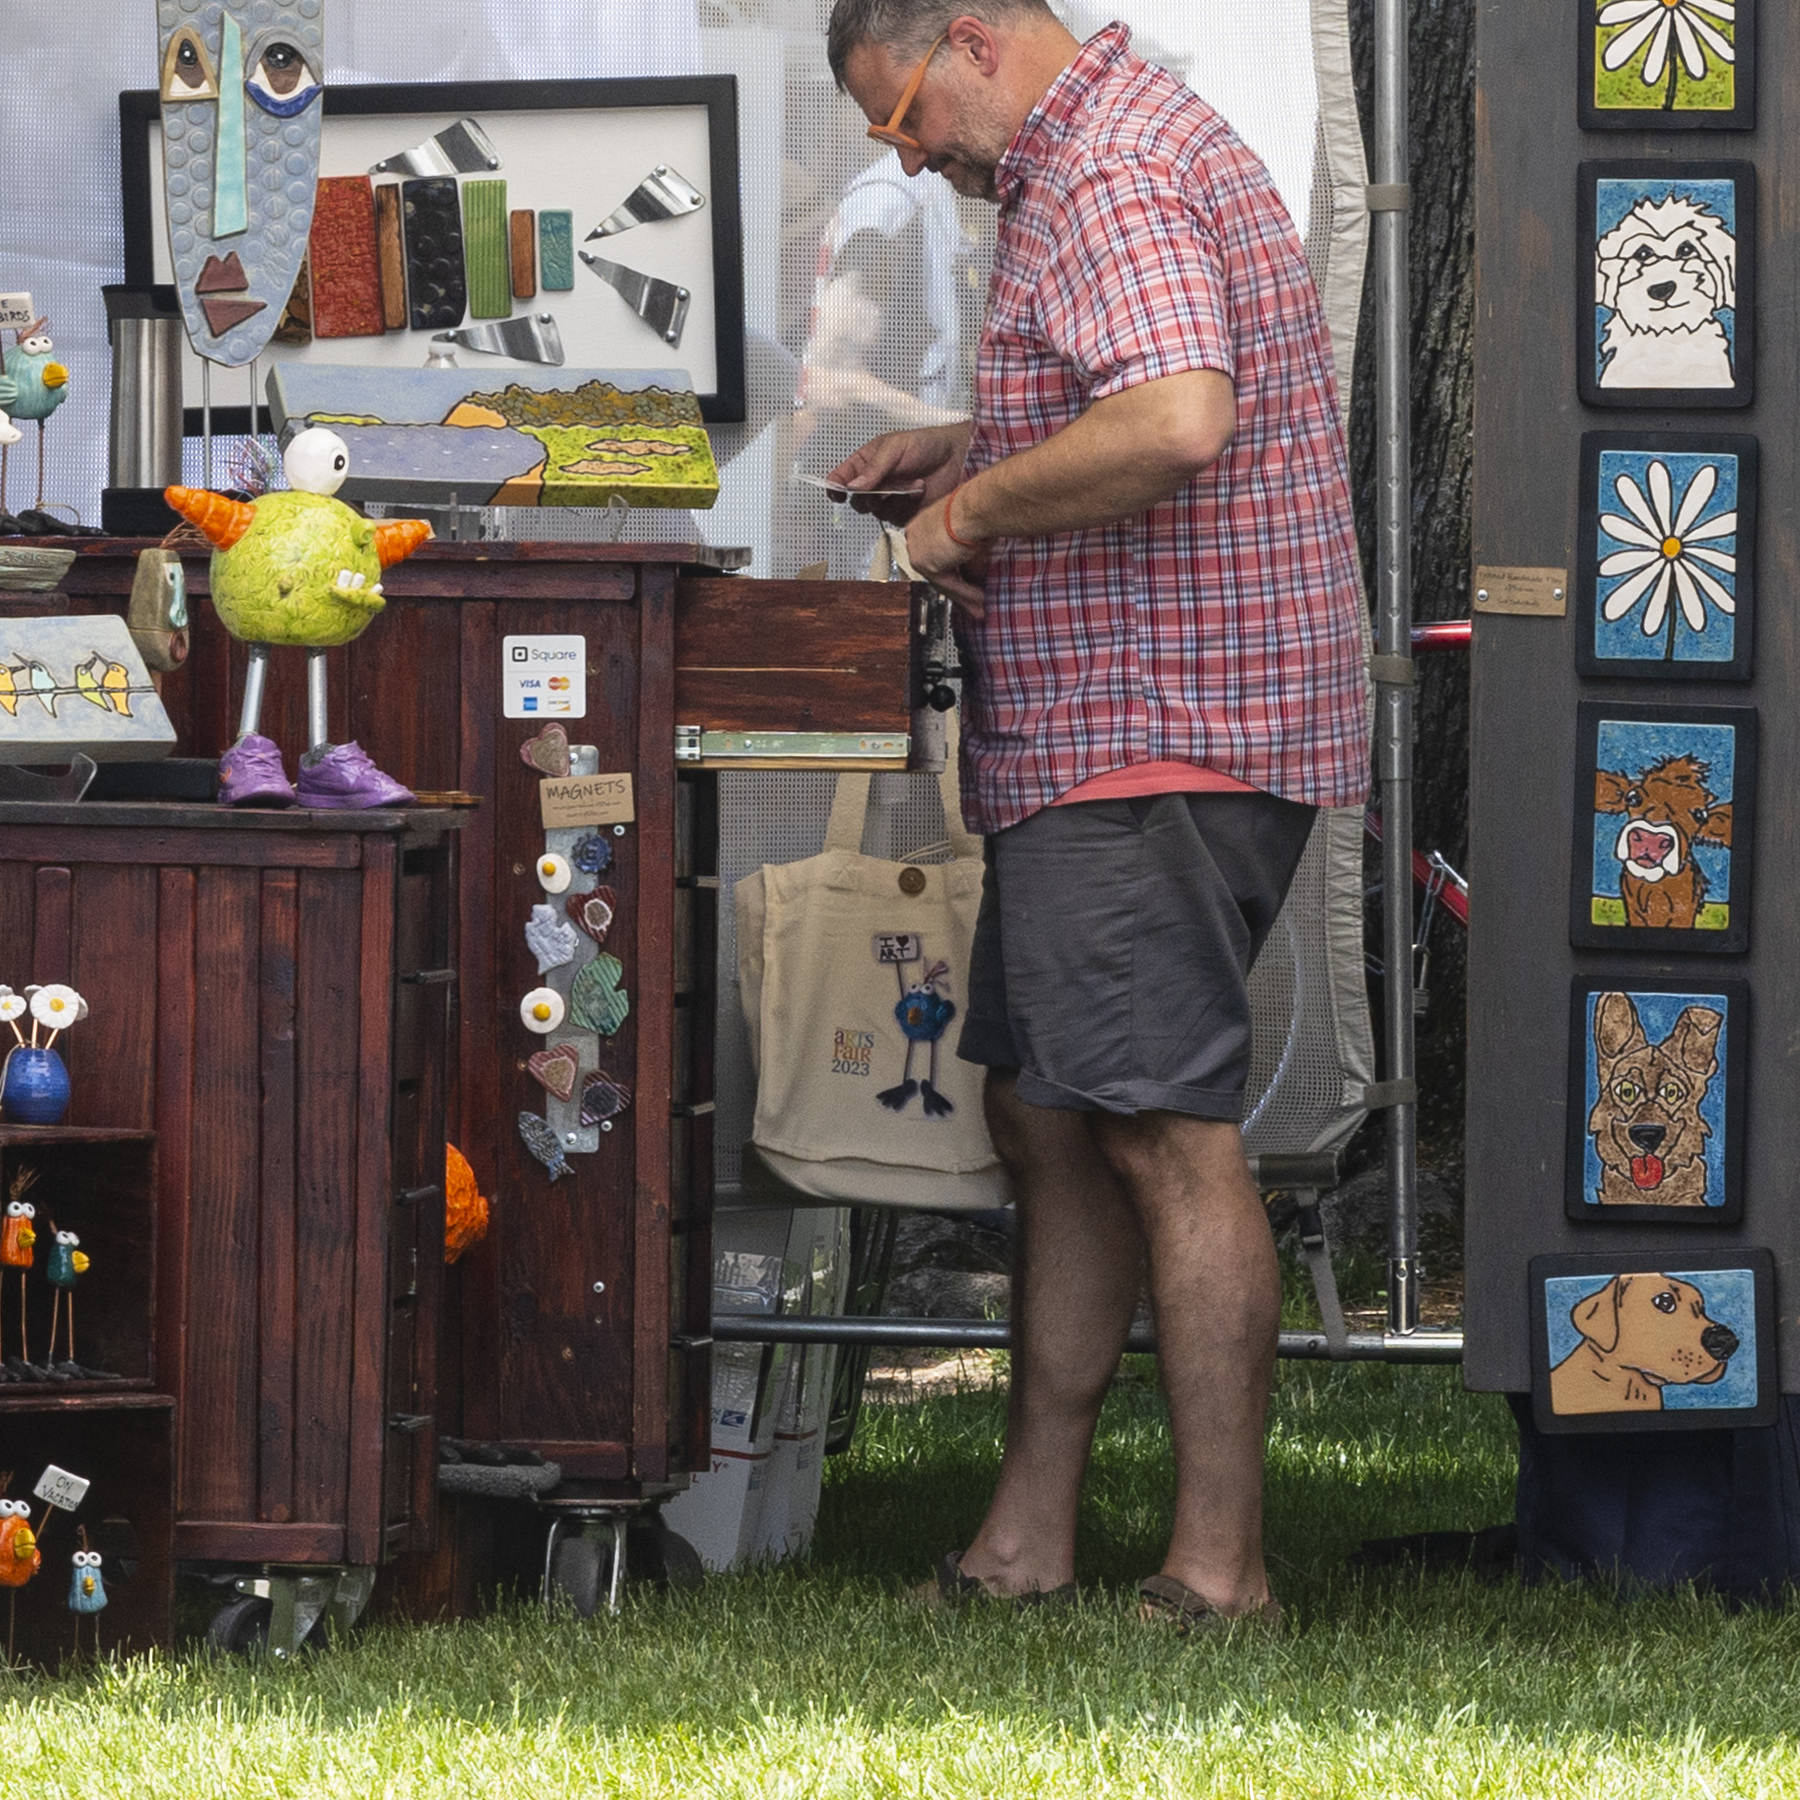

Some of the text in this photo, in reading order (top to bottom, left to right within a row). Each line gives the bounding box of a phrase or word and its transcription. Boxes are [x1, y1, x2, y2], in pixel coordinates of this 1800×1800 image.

[531, 649, 577, 662] Square
[520, 679, 541, 688] VISA
[545, 779, 626, 801] MAGNETS
[880, 937, 894, 948] I
[880, 947, 910, 959] ART
[831, 1059, 871, 1076] 2023
[55, 1475, 74, 1491] ON
